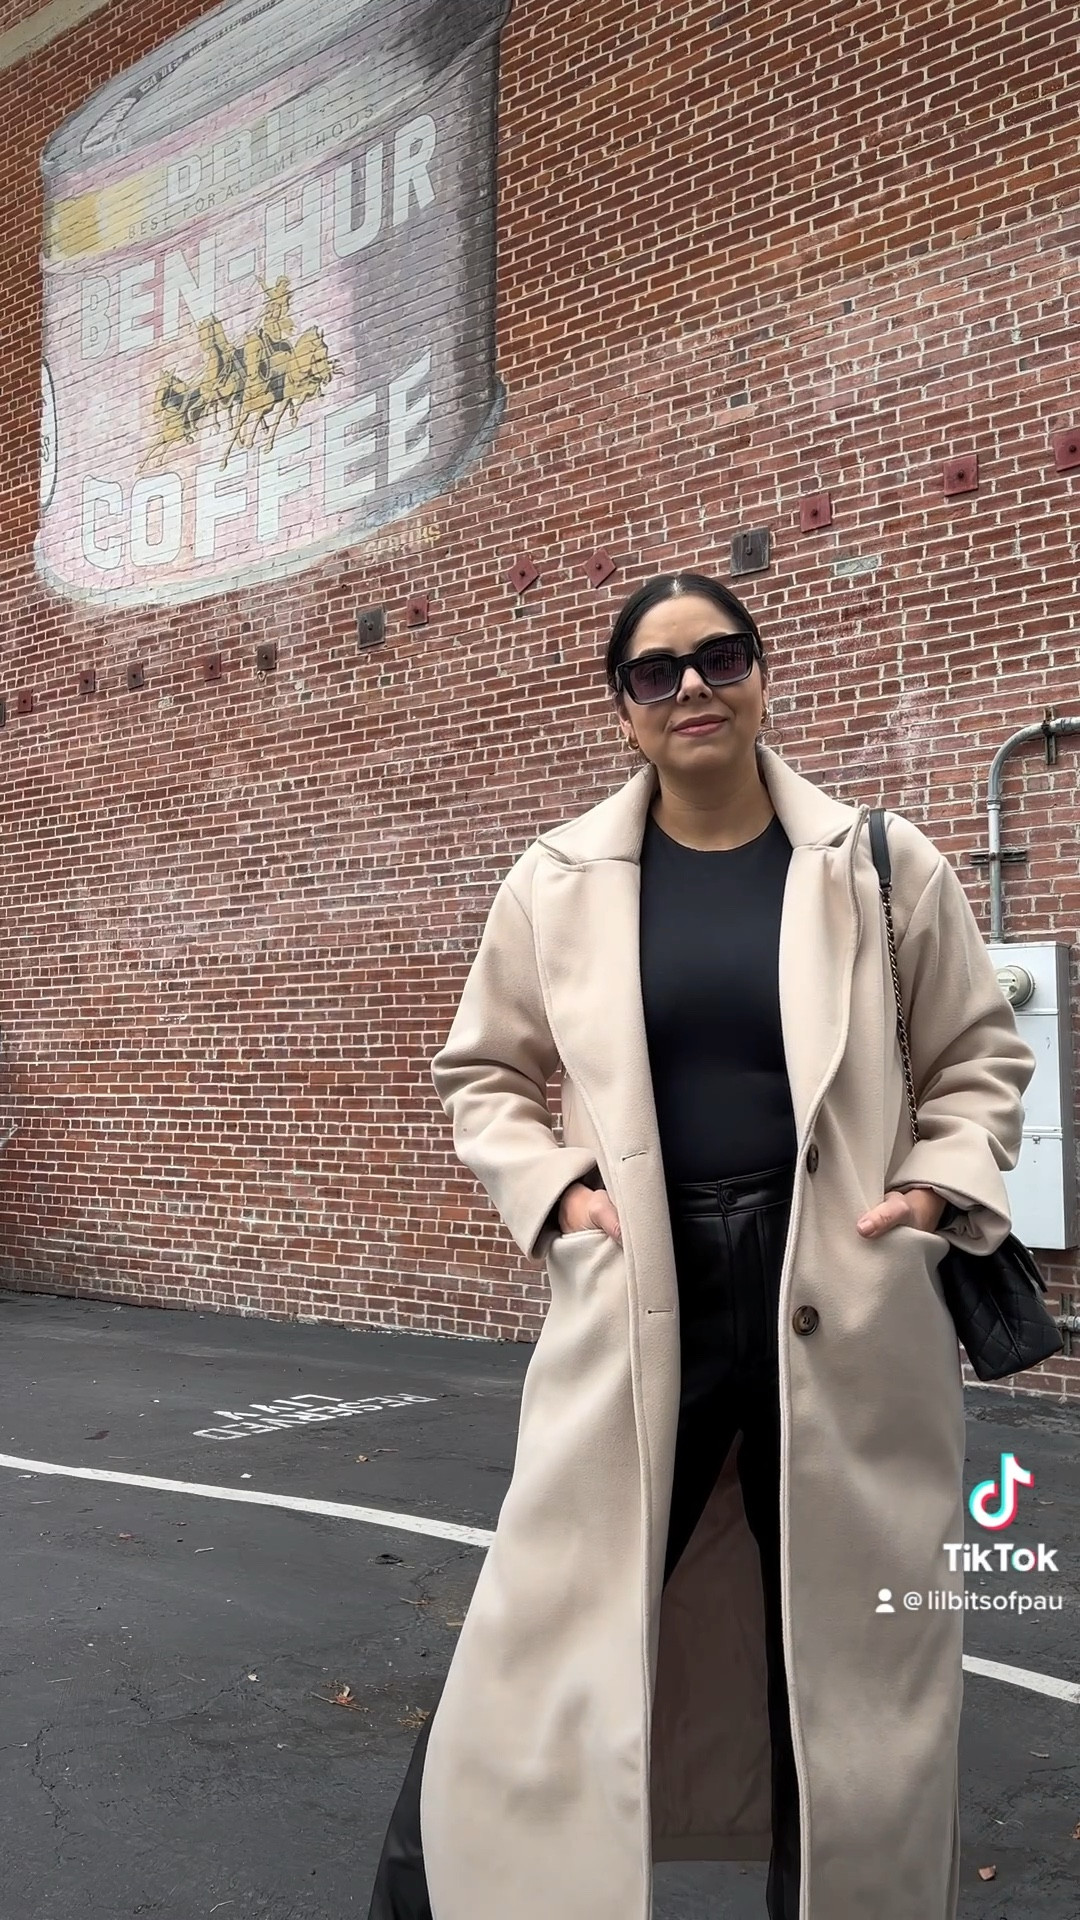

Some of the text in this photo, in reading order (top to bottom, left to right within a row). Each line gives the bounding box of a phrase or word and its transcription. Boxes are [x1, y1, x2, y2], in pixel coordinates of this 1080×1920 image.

[127, 211, 170, 240] BEST
[182, 192, 216, 219] FOR
[273, 103, 376, 174] METHODS
[166, 85, 331, 207] DRIP
[80, 114, 438, 361] BEN-HUR
[81, 348, 432, 571] COFFEE
[193, 1393, 438, 1440] RESERVED
